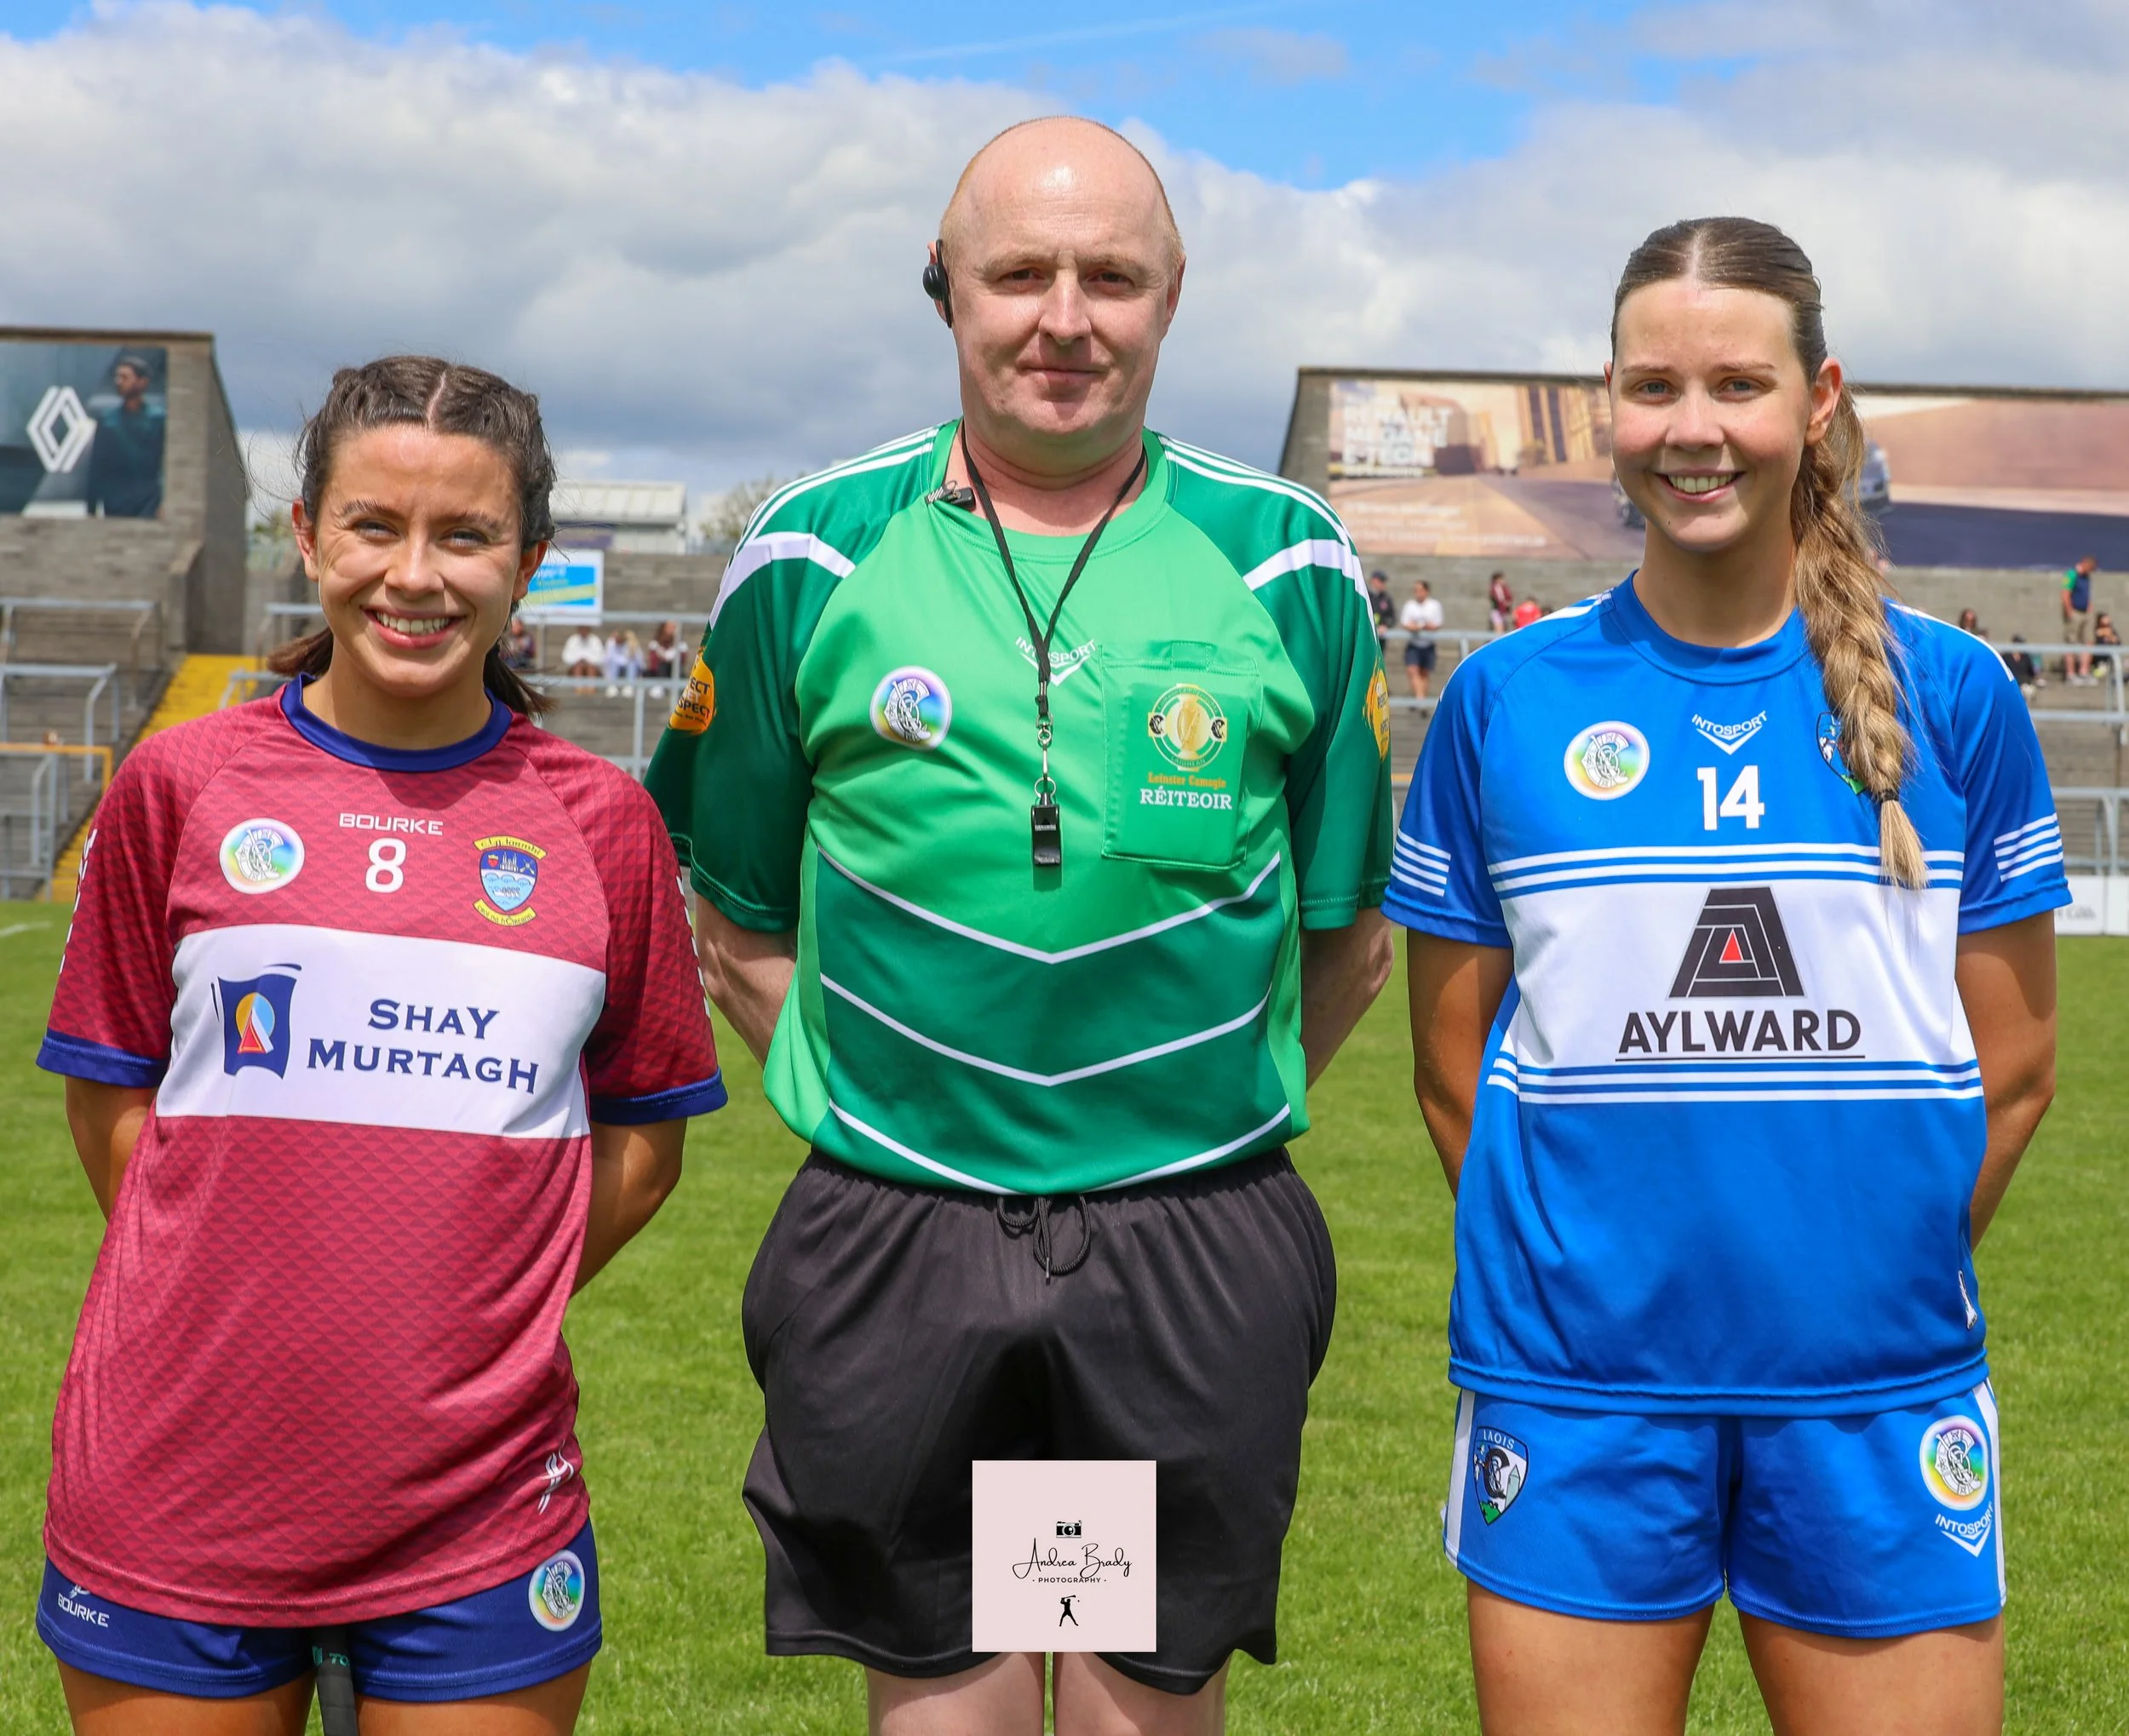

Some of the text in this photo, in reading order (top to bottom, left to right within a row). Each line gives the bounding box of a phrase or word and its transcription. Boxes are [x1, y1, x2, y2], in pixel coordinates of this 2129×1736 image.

[1015, 636, 1097, 663] INTSPORT
[1691, 710, 1768, 736] INTOSPORT
[1139, 785, 1233, 810] RÉITEOIR
[1696, 765, 1765, 831] 14
[339, 812, 444, 836] BOURKE
[364, 837, 407, 894] 8
[367, 998, 501, 1040] SHAY
[1618, 1008, 1862, 1054] AYLWARD
[307, 1037, 540, 1095] MURTAGH
[1483, 1429, 1515, 1451] LAOIS
[1935, 1500, 1994, 1535] INTOSPORT
[58, 1592, 110, 1628] BOURKE
